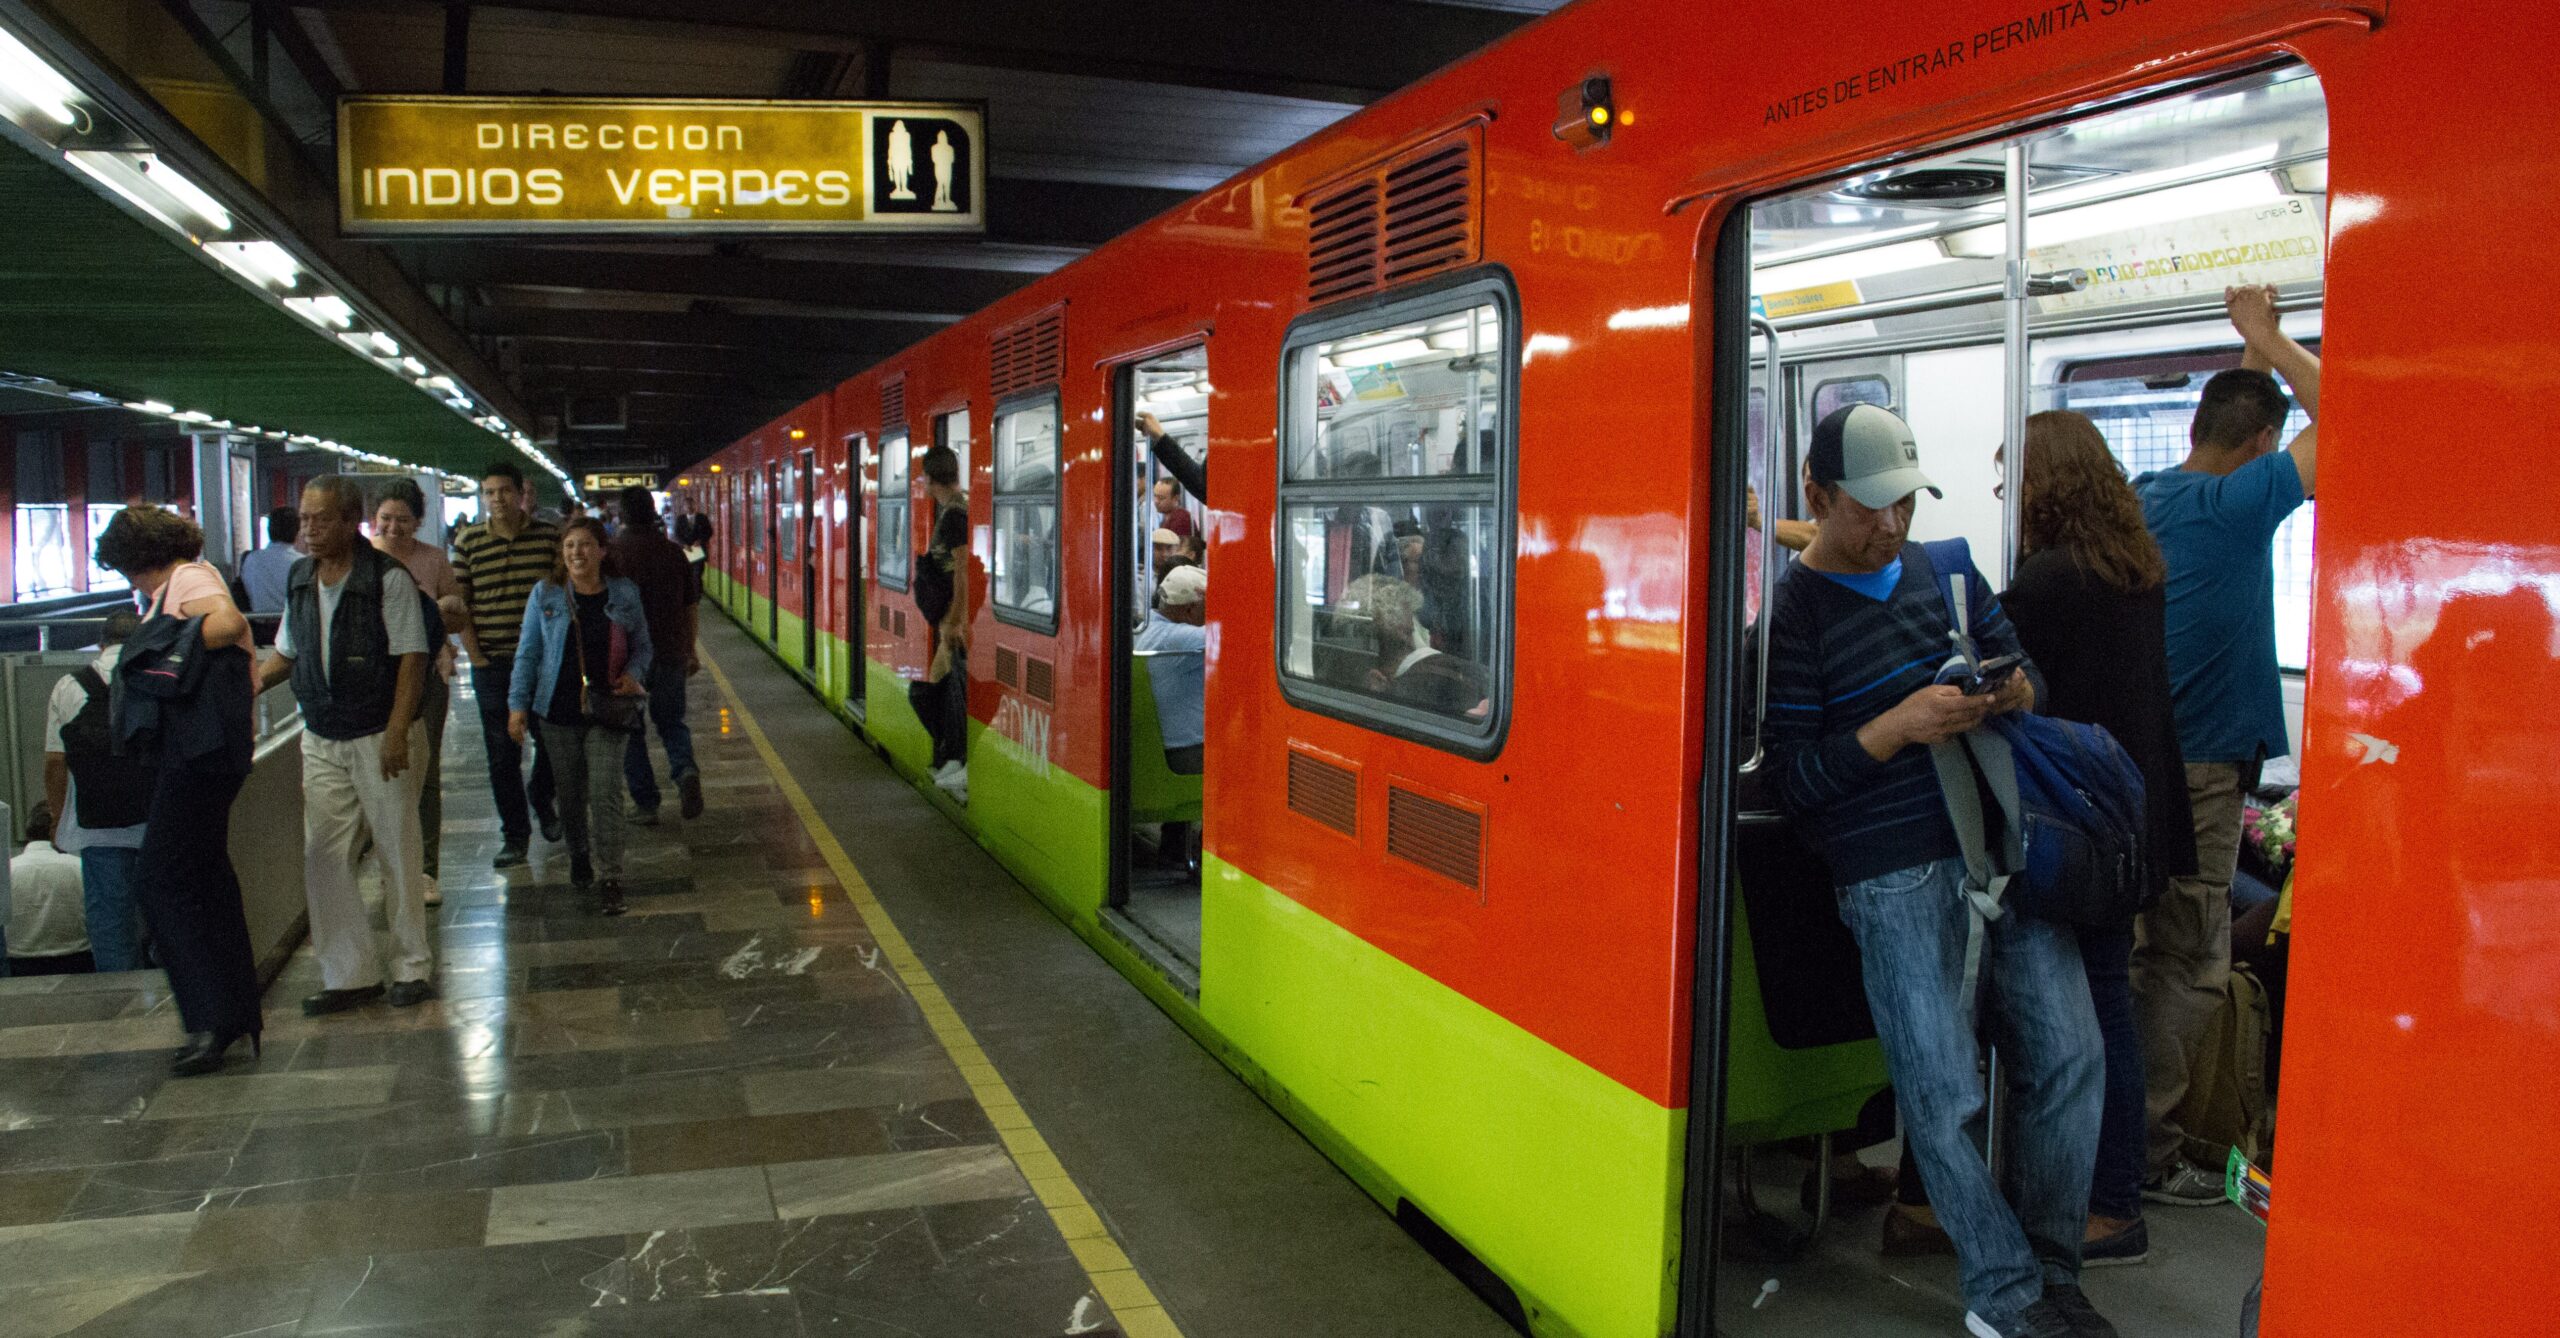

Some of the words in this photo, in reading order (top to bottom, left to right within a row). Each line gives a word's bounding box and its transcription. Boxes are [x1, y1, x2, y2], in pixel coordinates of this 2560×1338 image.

[1763, 87, 1828, 125] ANTES
[1834, 75, 1861, 104] DE
[1868, 41, 1965, 93] ENTRAR
[1973, 0, 2090, 59] PERMITA
[476, 123, 743, 151] DIRECCION
[363, 168, 565, 206] INDIOS
[606, 168, 851, 206] VERDES
[2288, 199, 2302, 214] 3
